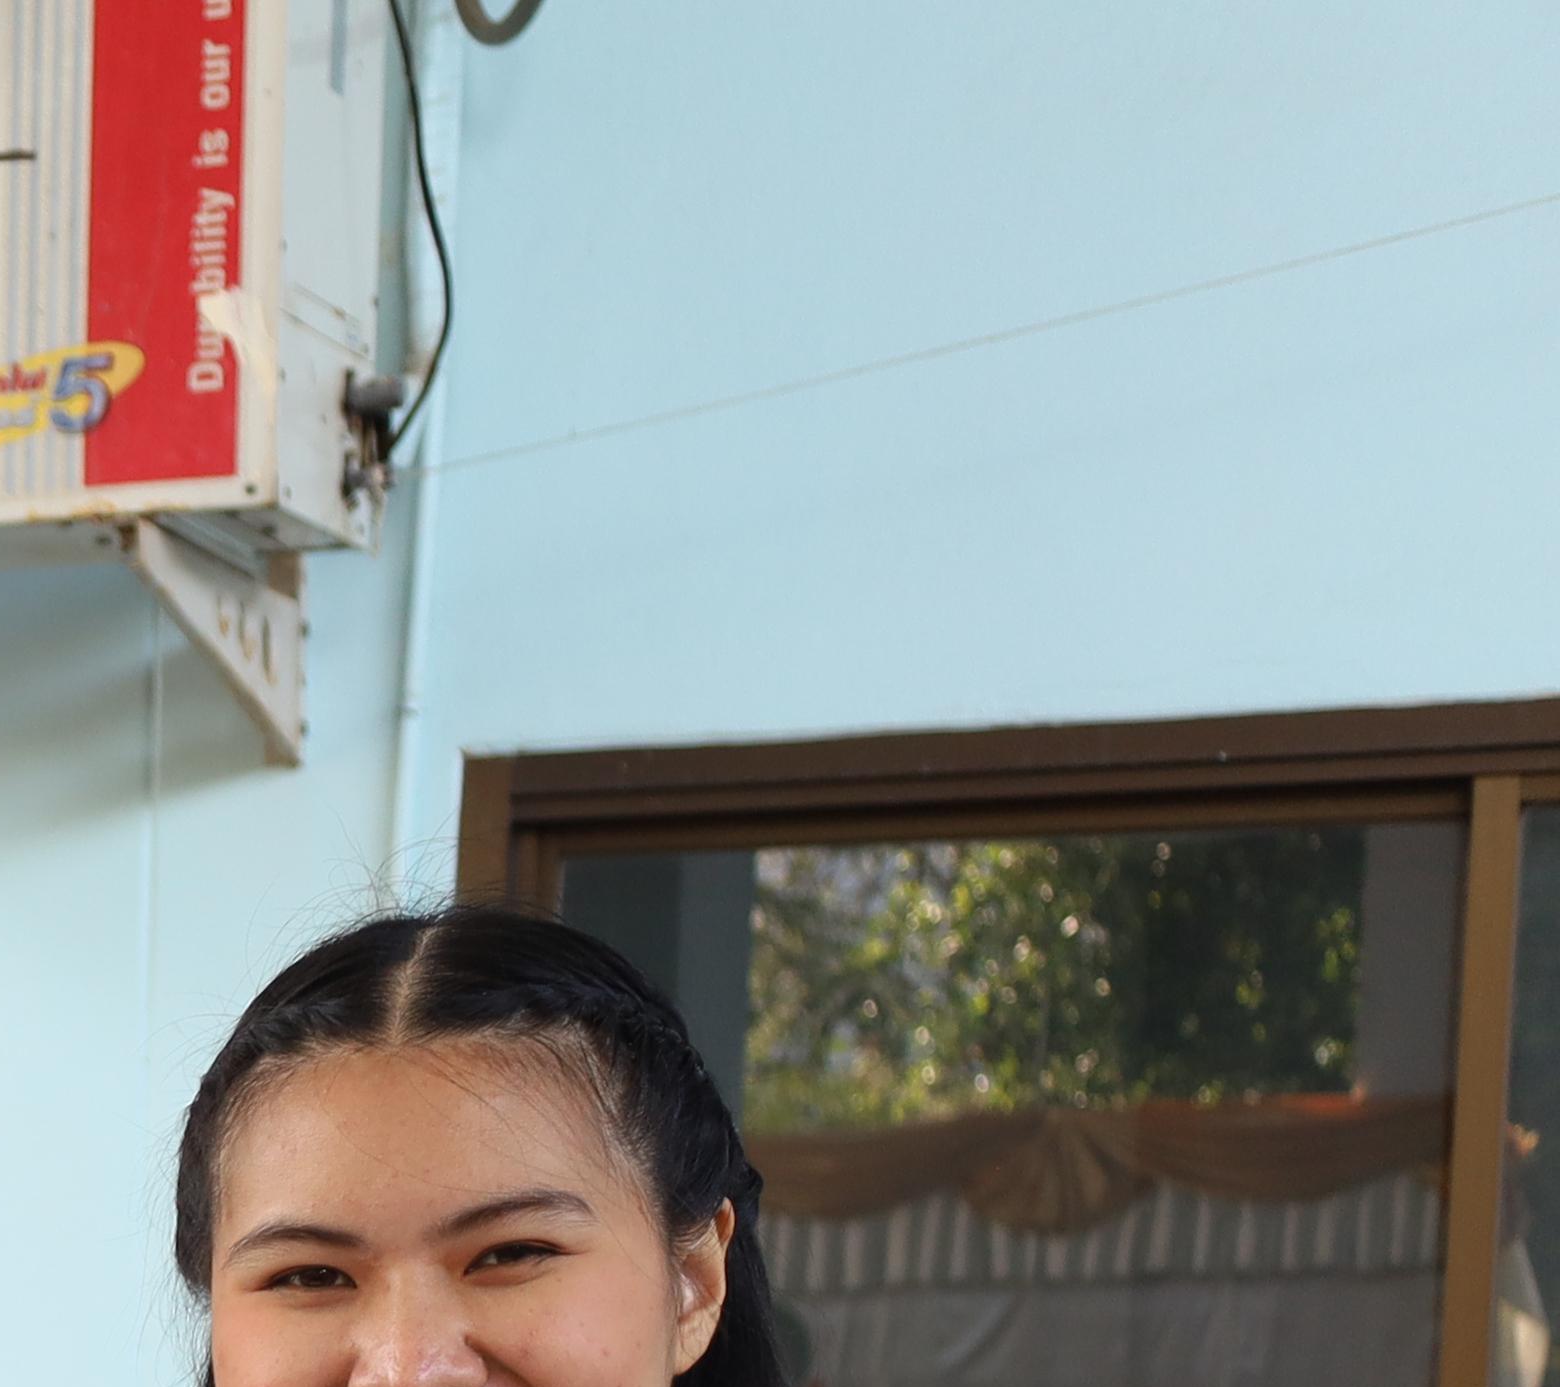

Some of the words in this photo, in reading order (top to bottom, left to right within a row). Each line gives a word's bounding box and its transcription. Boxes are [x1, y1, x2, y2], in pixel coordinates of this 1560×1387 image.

[200, 38, 232, 110] our
[193, 128, 230, 169] is
[186, 187, 237, 392] Durbility
[51, 352, 115, 434] 5
